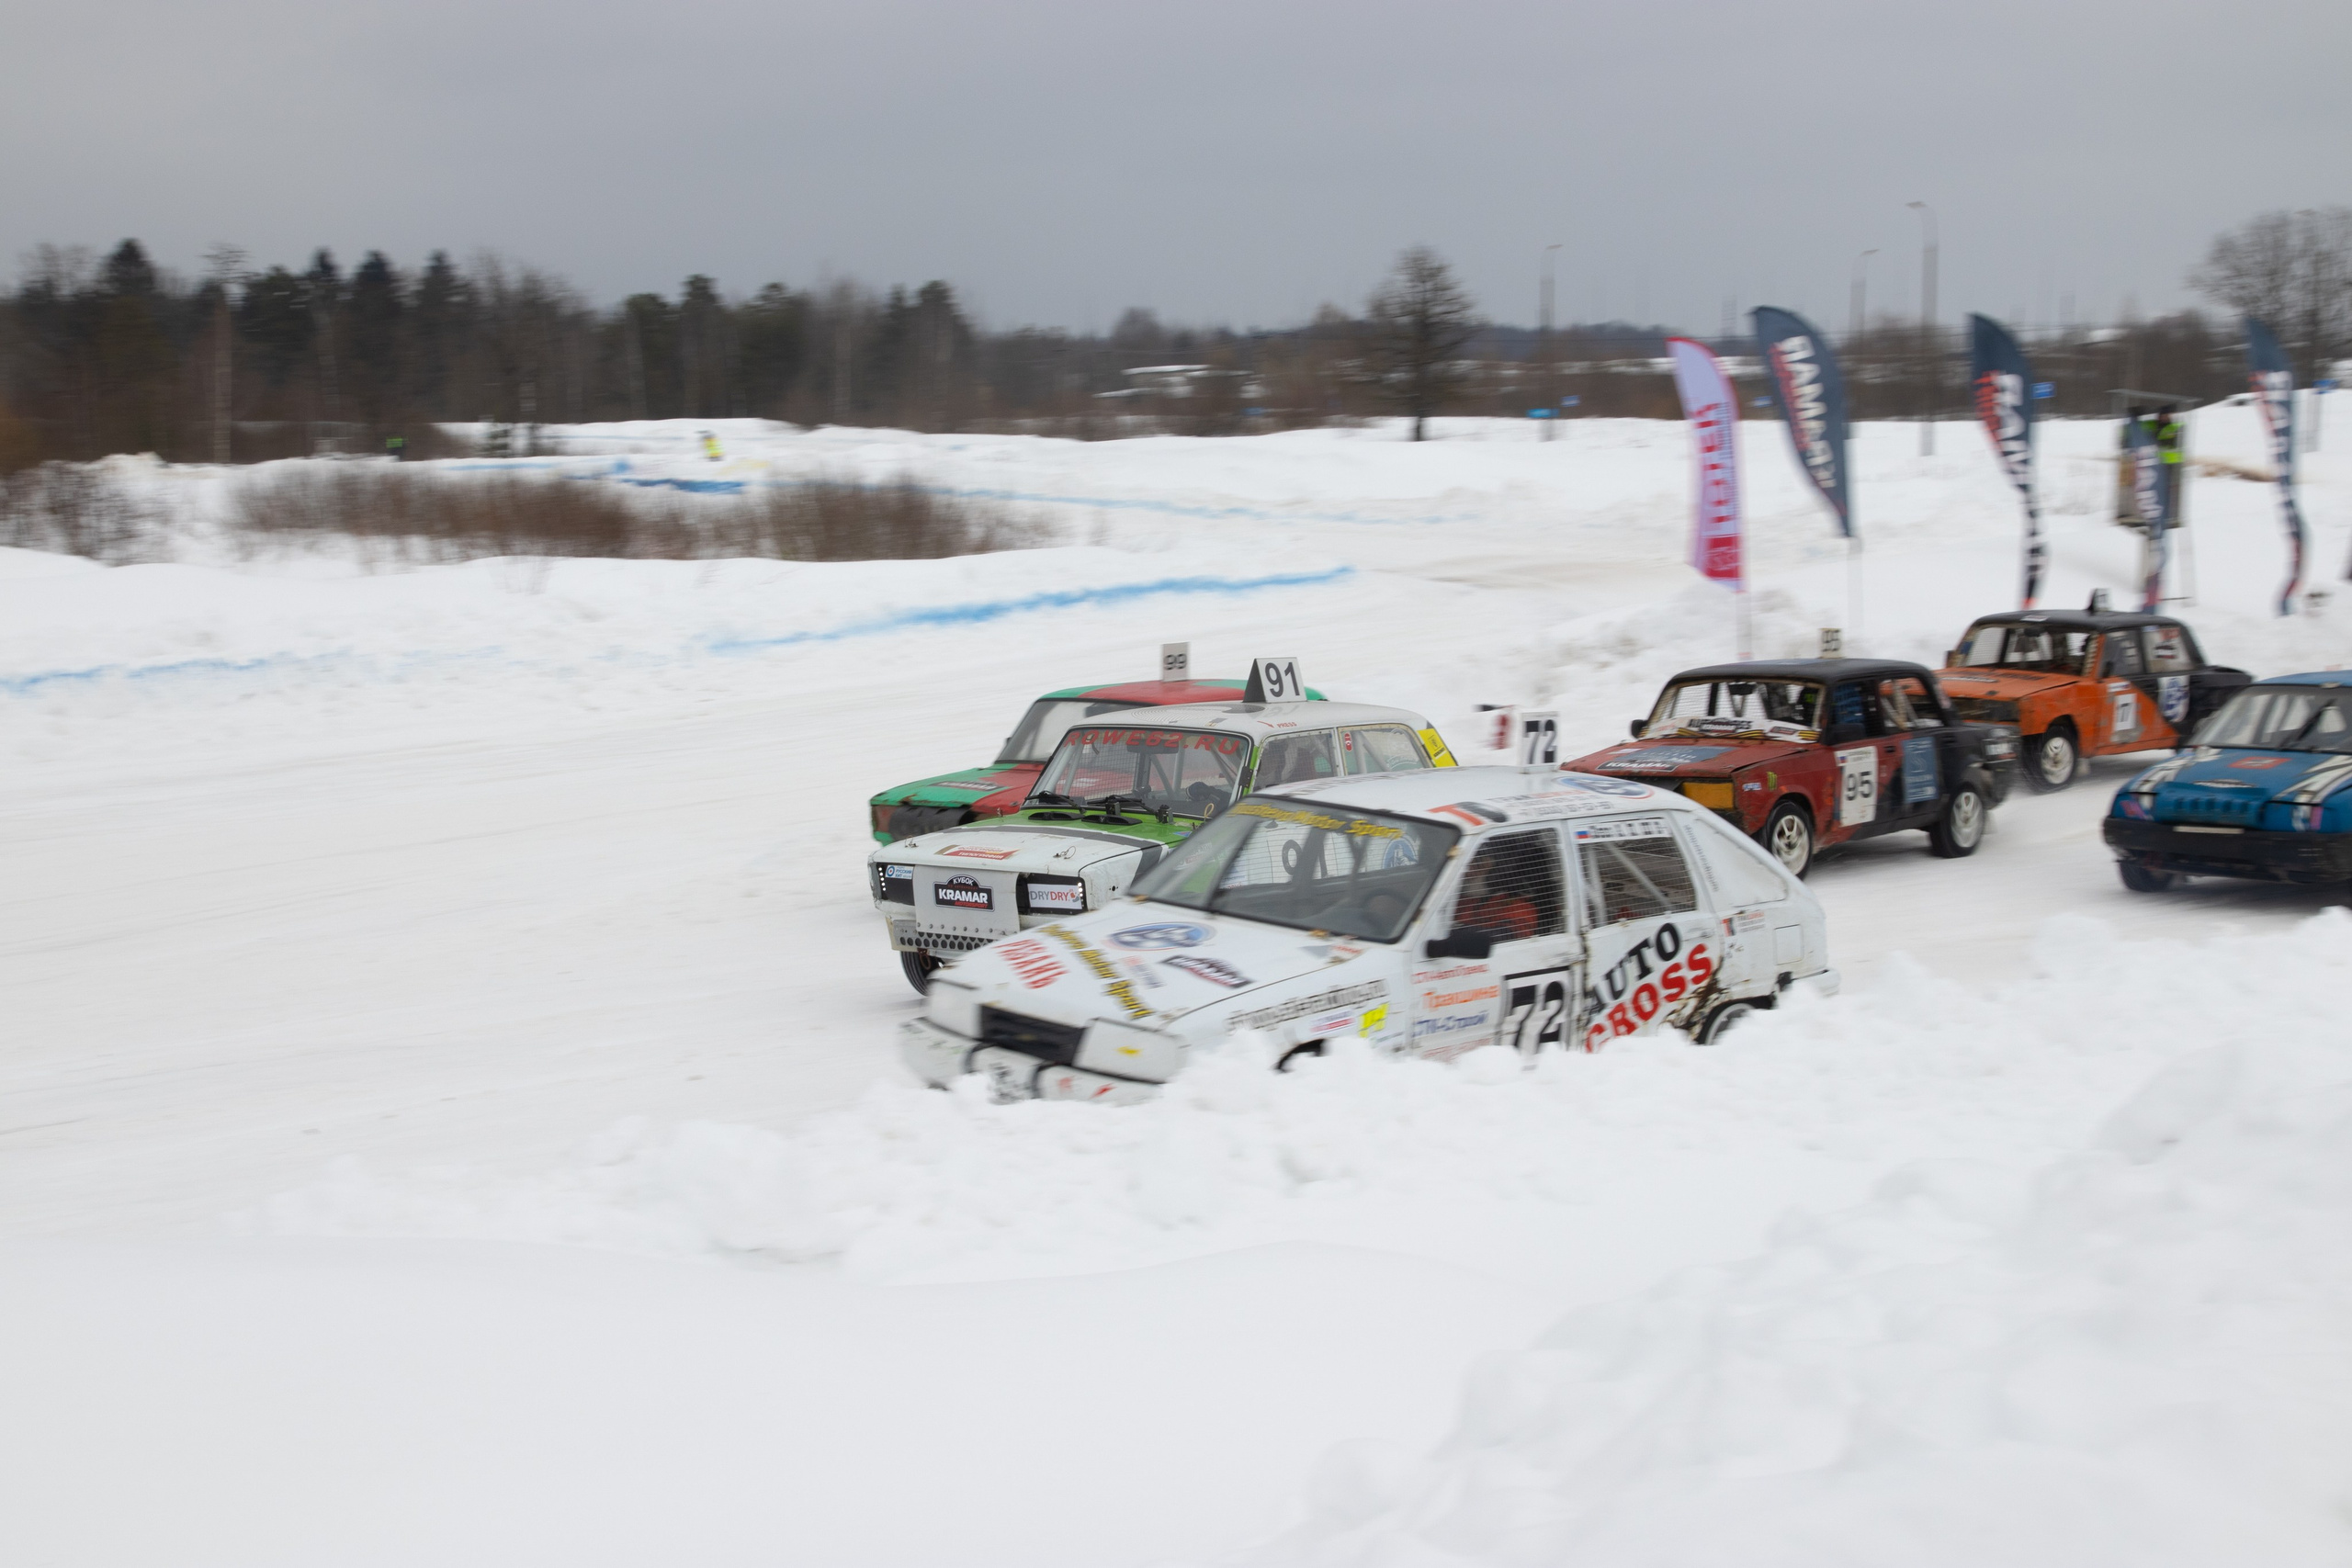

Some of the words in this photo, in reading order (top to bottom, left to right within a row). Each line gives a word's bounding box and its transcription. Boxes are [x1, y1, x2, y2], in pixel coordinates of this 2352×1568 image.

[1163, 652, 1188, 671] 99
[1264, 661, 1301, 698] 91
[1064, 728, 1241, 755] ROWE62.RU
[1523, 719, 1557, 764] 72
[1845, 771, 1873, 801] 95
[938, 887, 989, 904] KRAMAR
[953, 876, 975, 886] КУБОК
[1586, 922, 1681, 1016] AUTO
[1585, 943, 1713, 1054] CROSS
[1505, 980, 1566, 1053] 72
